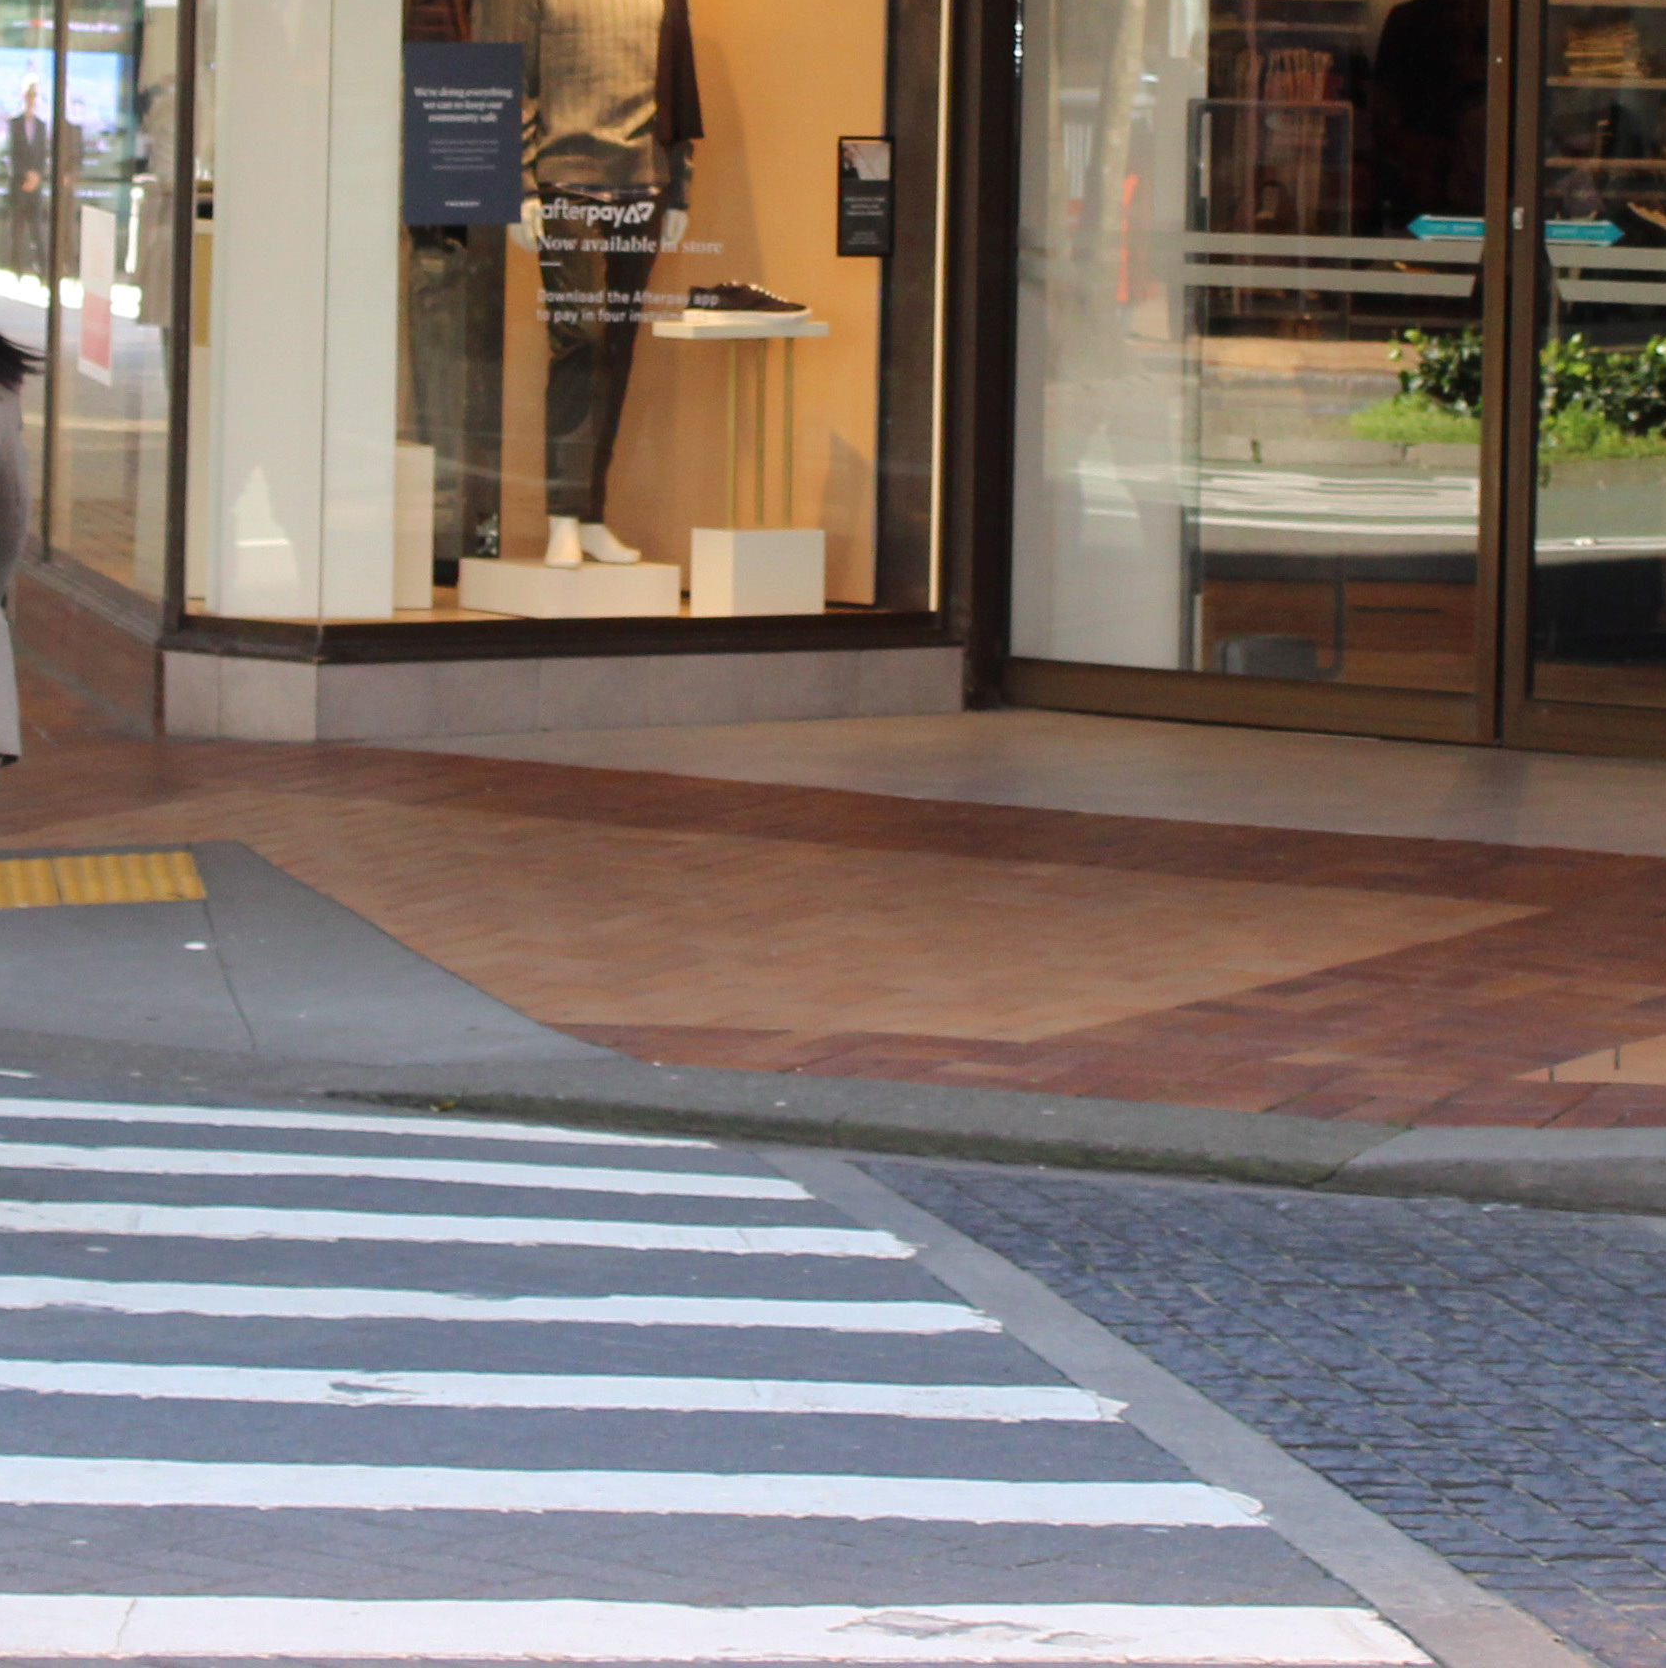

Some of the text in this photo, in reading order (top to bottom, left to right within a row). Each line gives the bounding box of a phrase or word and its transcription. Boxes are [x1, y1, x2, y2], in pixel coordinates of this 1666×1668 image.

[541, 197, 624, 228] afterpay
[539, 235, 578, 251] Now
[580, 235, 657, 253] available
[682, 240, 723, 254] store
[537, 287, 604, 304] Download
[608, 289, 629, 304] the
[692, 293, 720, 308] app
[553, 309, 579, 324] pay
[597, 307, 627, 323] four
